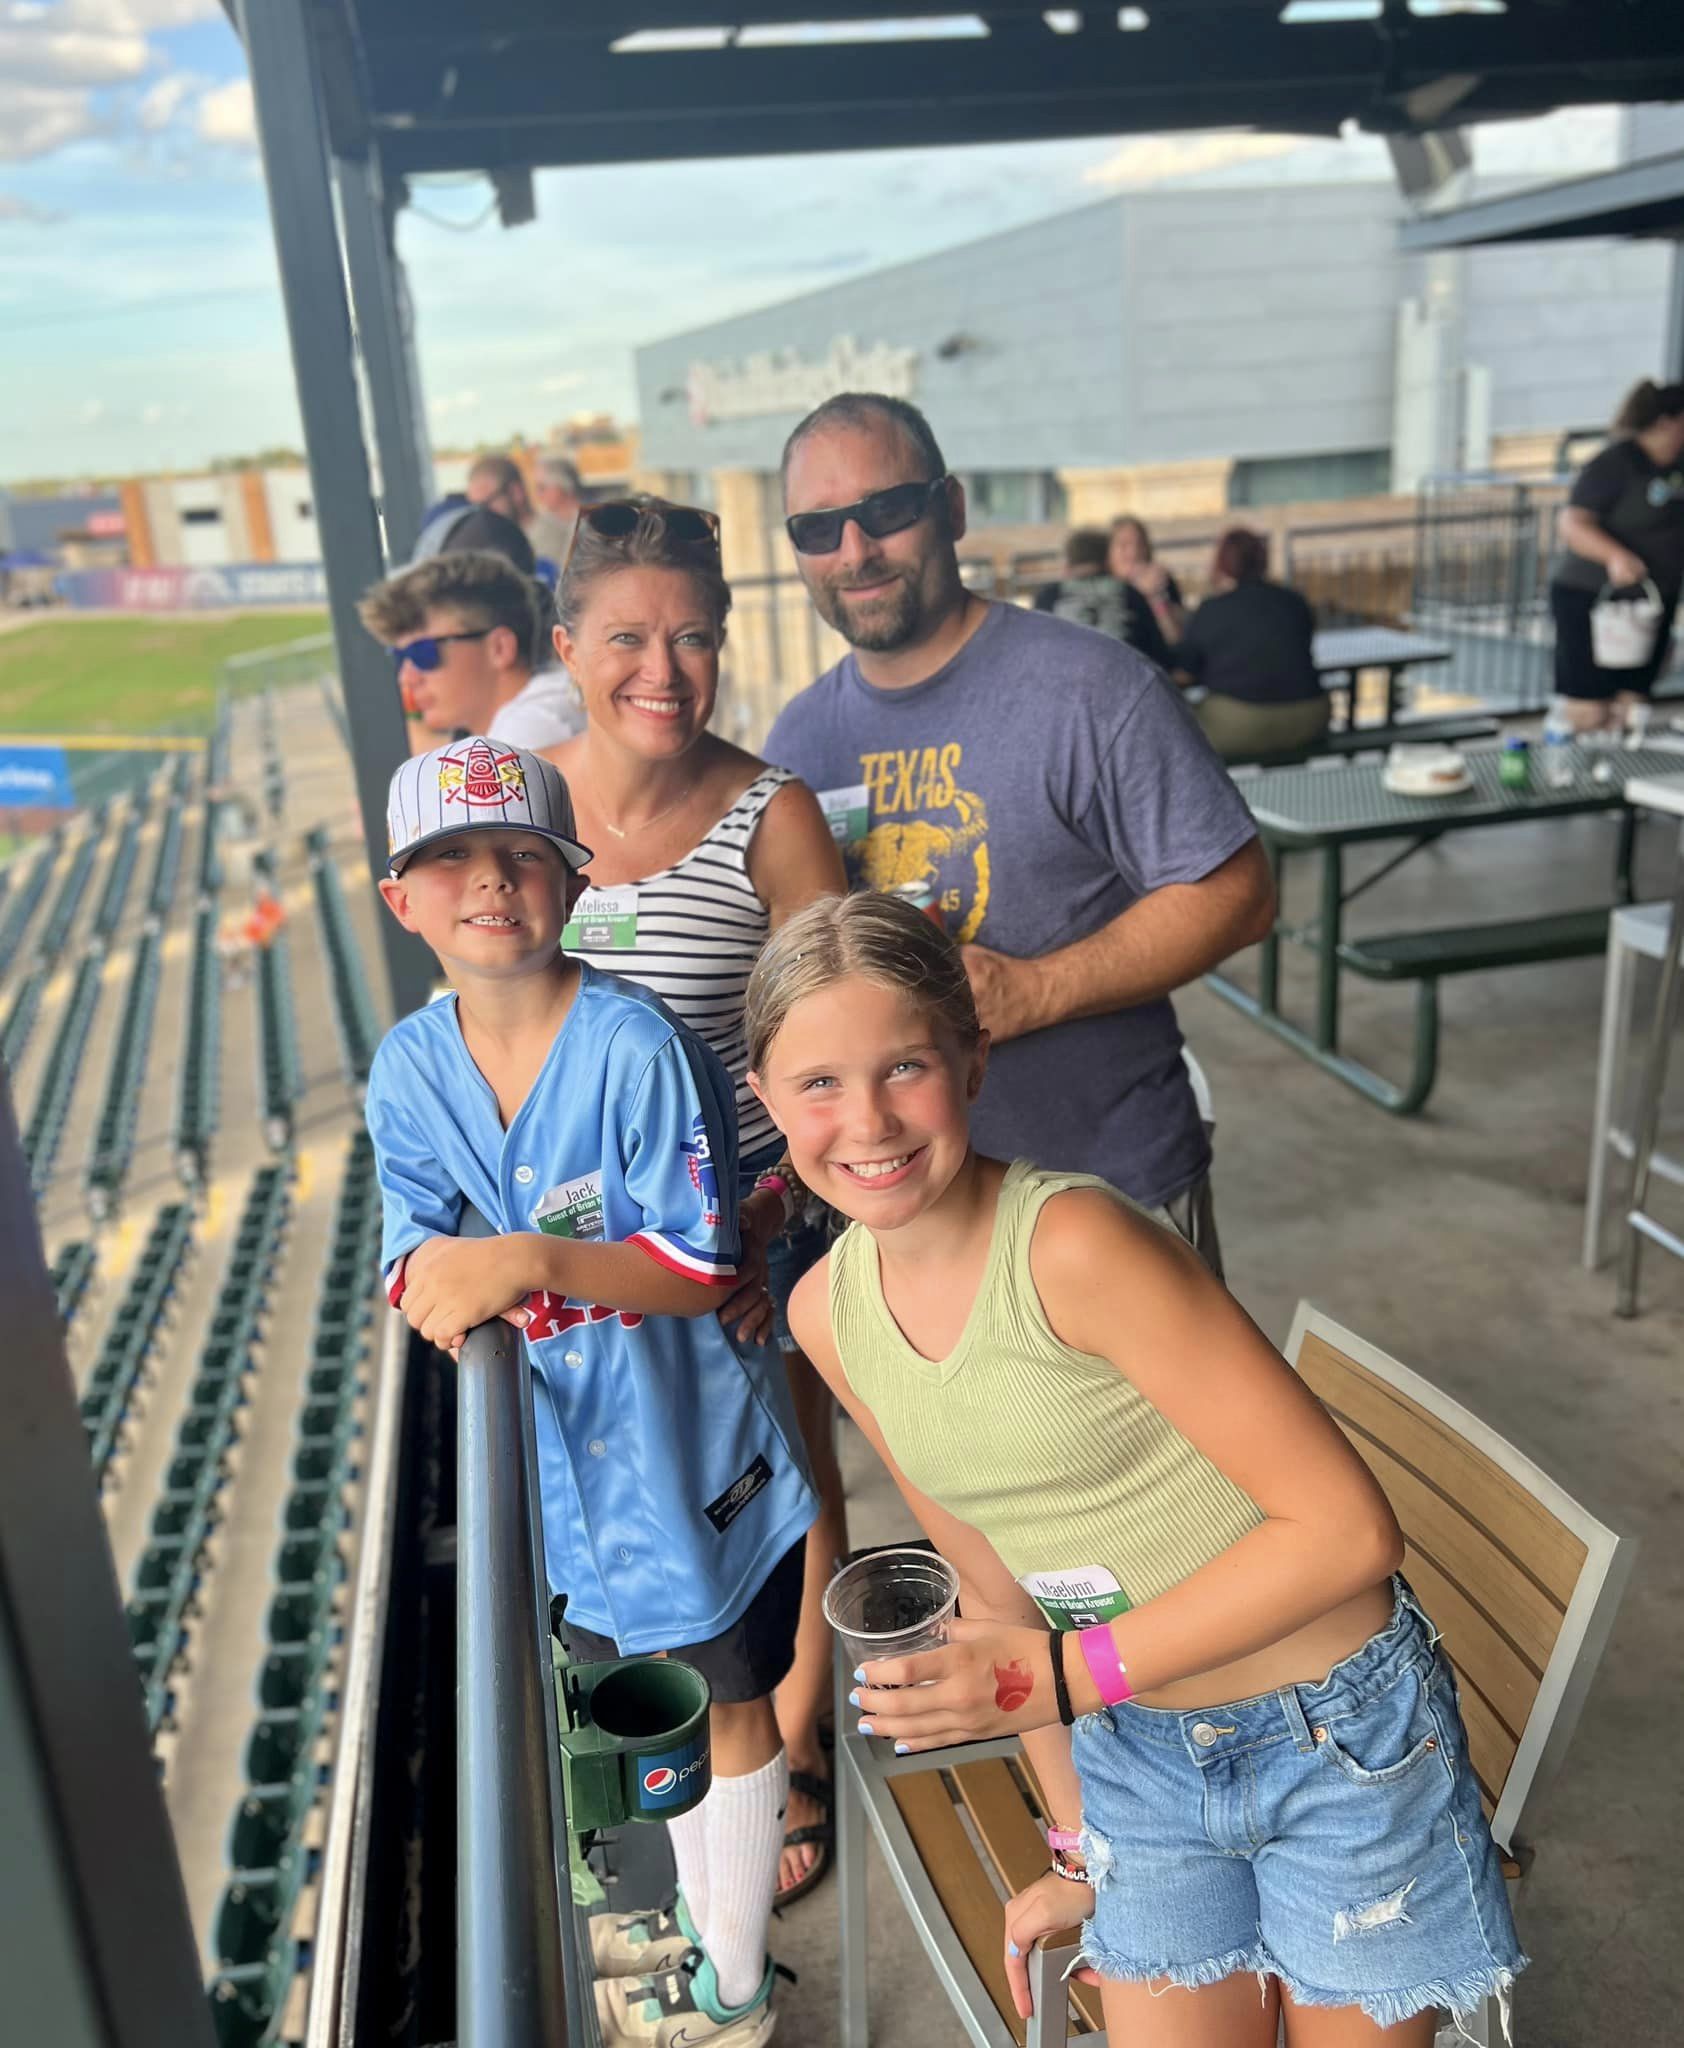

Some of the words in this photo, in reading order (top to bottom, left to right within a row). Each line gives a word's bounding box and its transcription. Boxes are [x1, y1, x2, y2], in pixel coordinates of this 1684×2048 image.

[859, 742, 962, 815] TEXAS
[577, 899, 619, 913] Melissa
[565, 1182, 597, 1204] Jack
[546, 1210, 568, 1223] Guest
[568, 1205, 576, 1216] of
[576, 1200, 596, 1212] Brian
[1036, 1580, 1097, 1599] Maelynn
